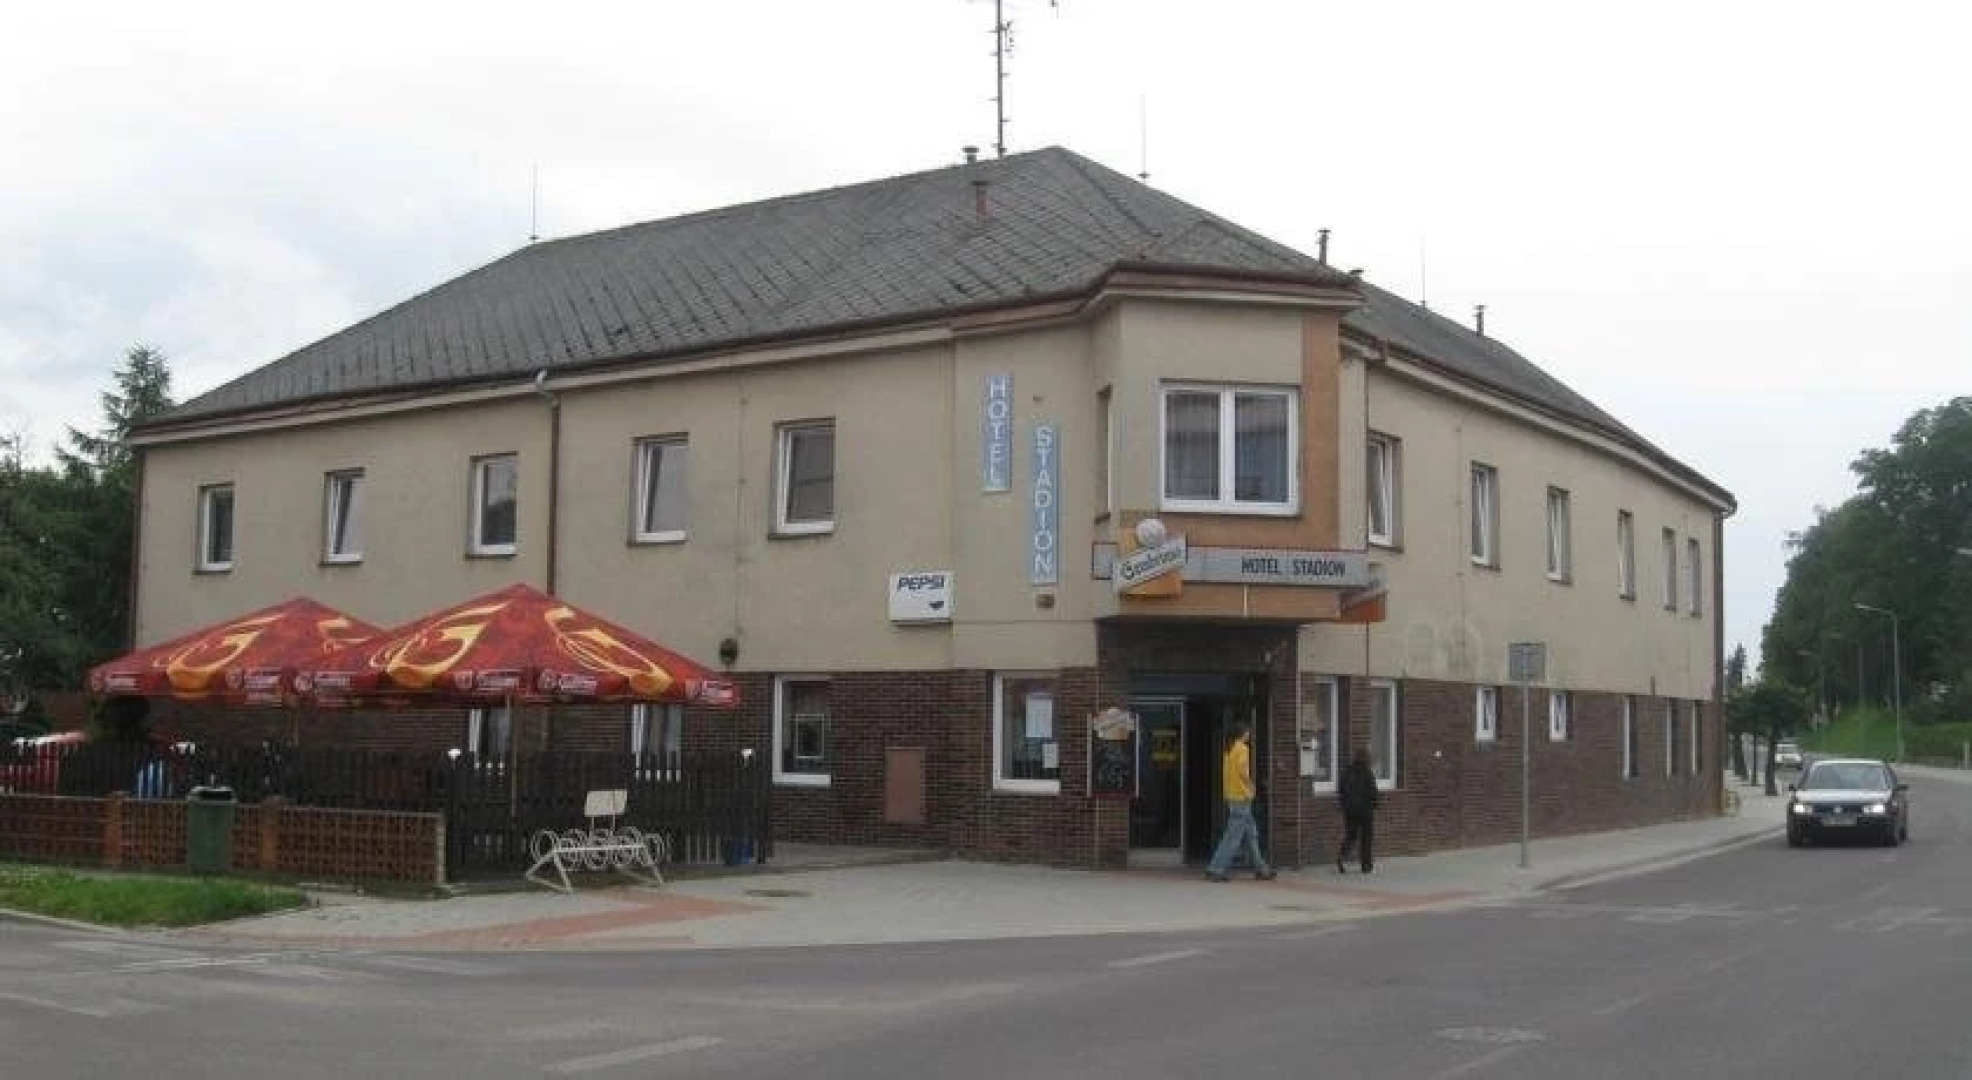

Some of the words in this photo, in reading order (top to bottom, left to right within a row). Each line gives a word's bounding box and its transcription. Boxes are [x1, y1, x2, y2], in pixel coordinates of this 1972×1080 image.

[988, 376, 1008, 485] HOTEL
[1034, 425, 1053, 576] STADION
[897, 574, 945, 591] PEPSI
[1241, 557, 1281, 575] HOTEL
[1293, 558, 1346, 577] STADION
